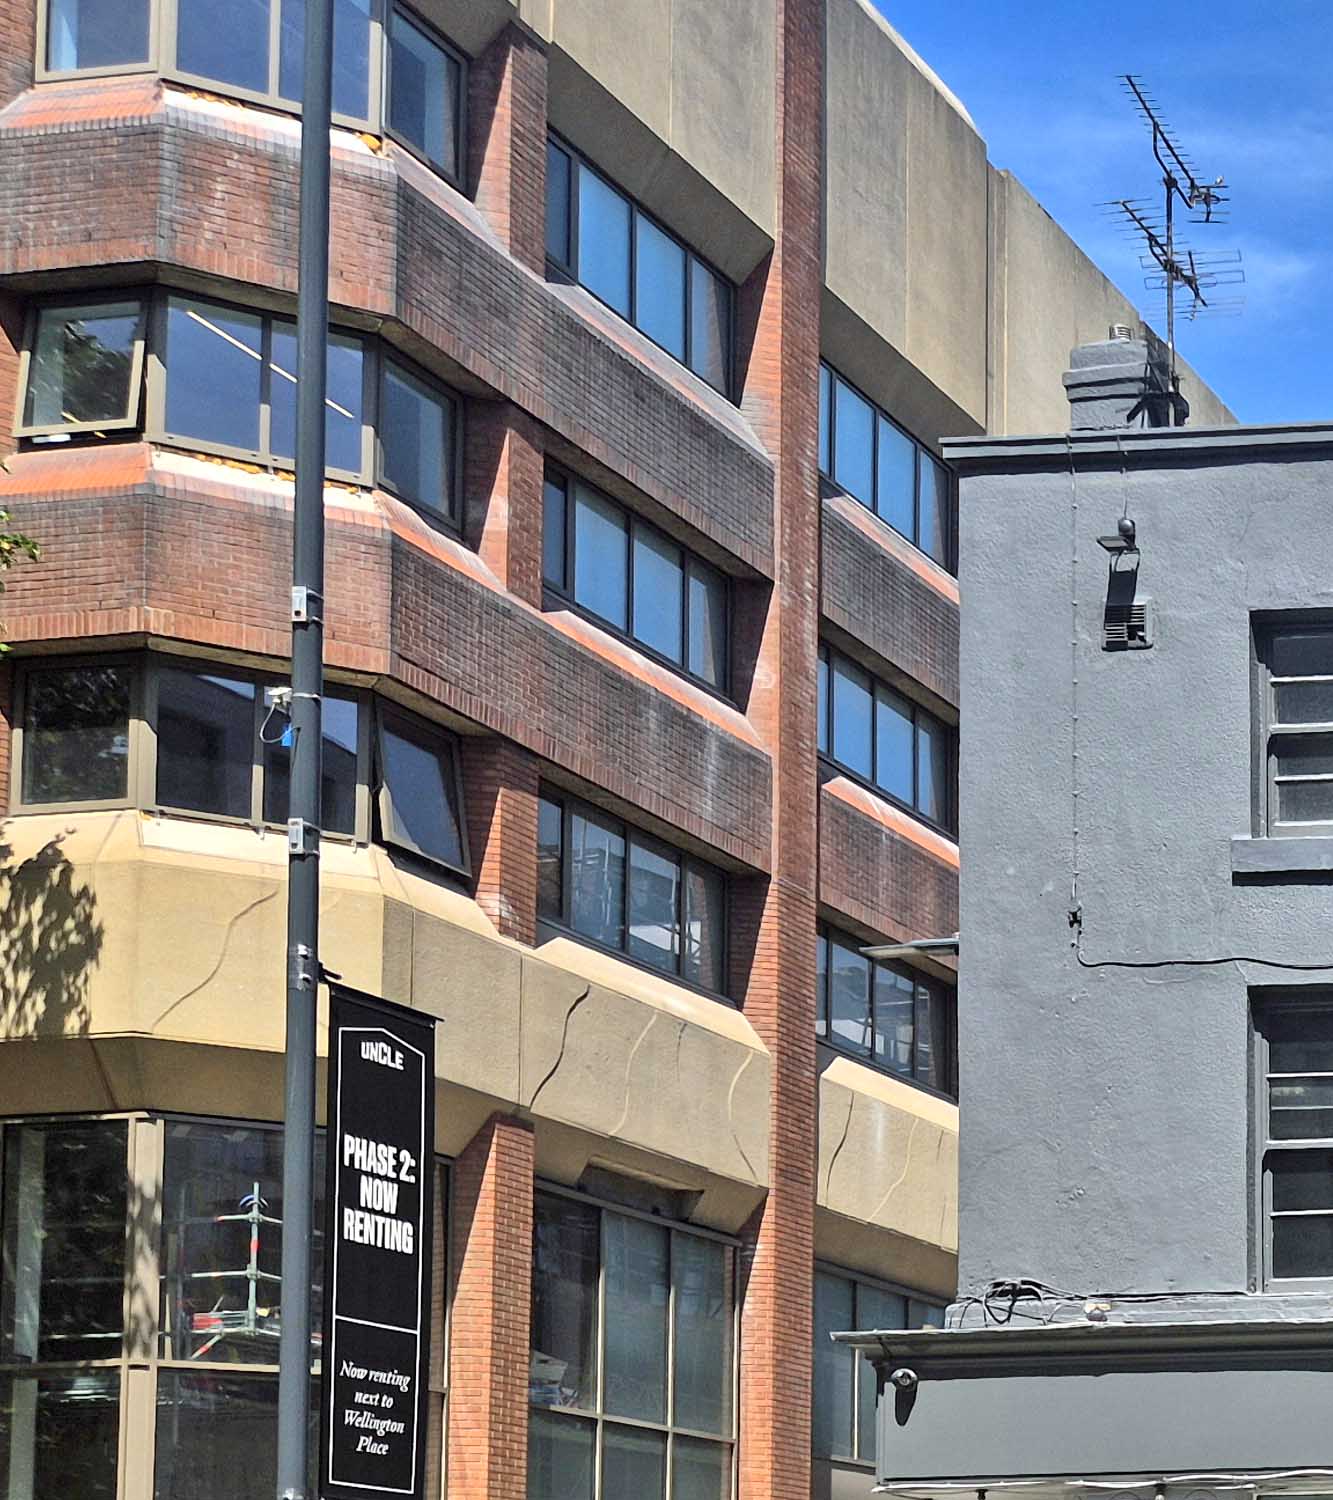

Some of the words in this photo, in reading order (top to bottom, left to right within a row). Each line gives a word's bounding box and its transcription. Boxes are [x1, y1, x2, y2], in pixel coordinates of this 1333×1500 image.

[361, 1041, 405, 1071] UNCLE
[343, 1133, 398, 1179] PHASE
[399, 1149, 416, 1184] 2:
[359, 1174, 399, 1215] NOW
[343, 1206, 414, 1255] RENTING
[340, 1359, 369, 1380] Now
[368, 1369, 412, 1393] renting
[354, 1391, 381, 1407] next
[381, 1394, 394, 1409] to
[344, 1408, 406, 1437] Wellington
[356, 1435, 390, 1456] Place
